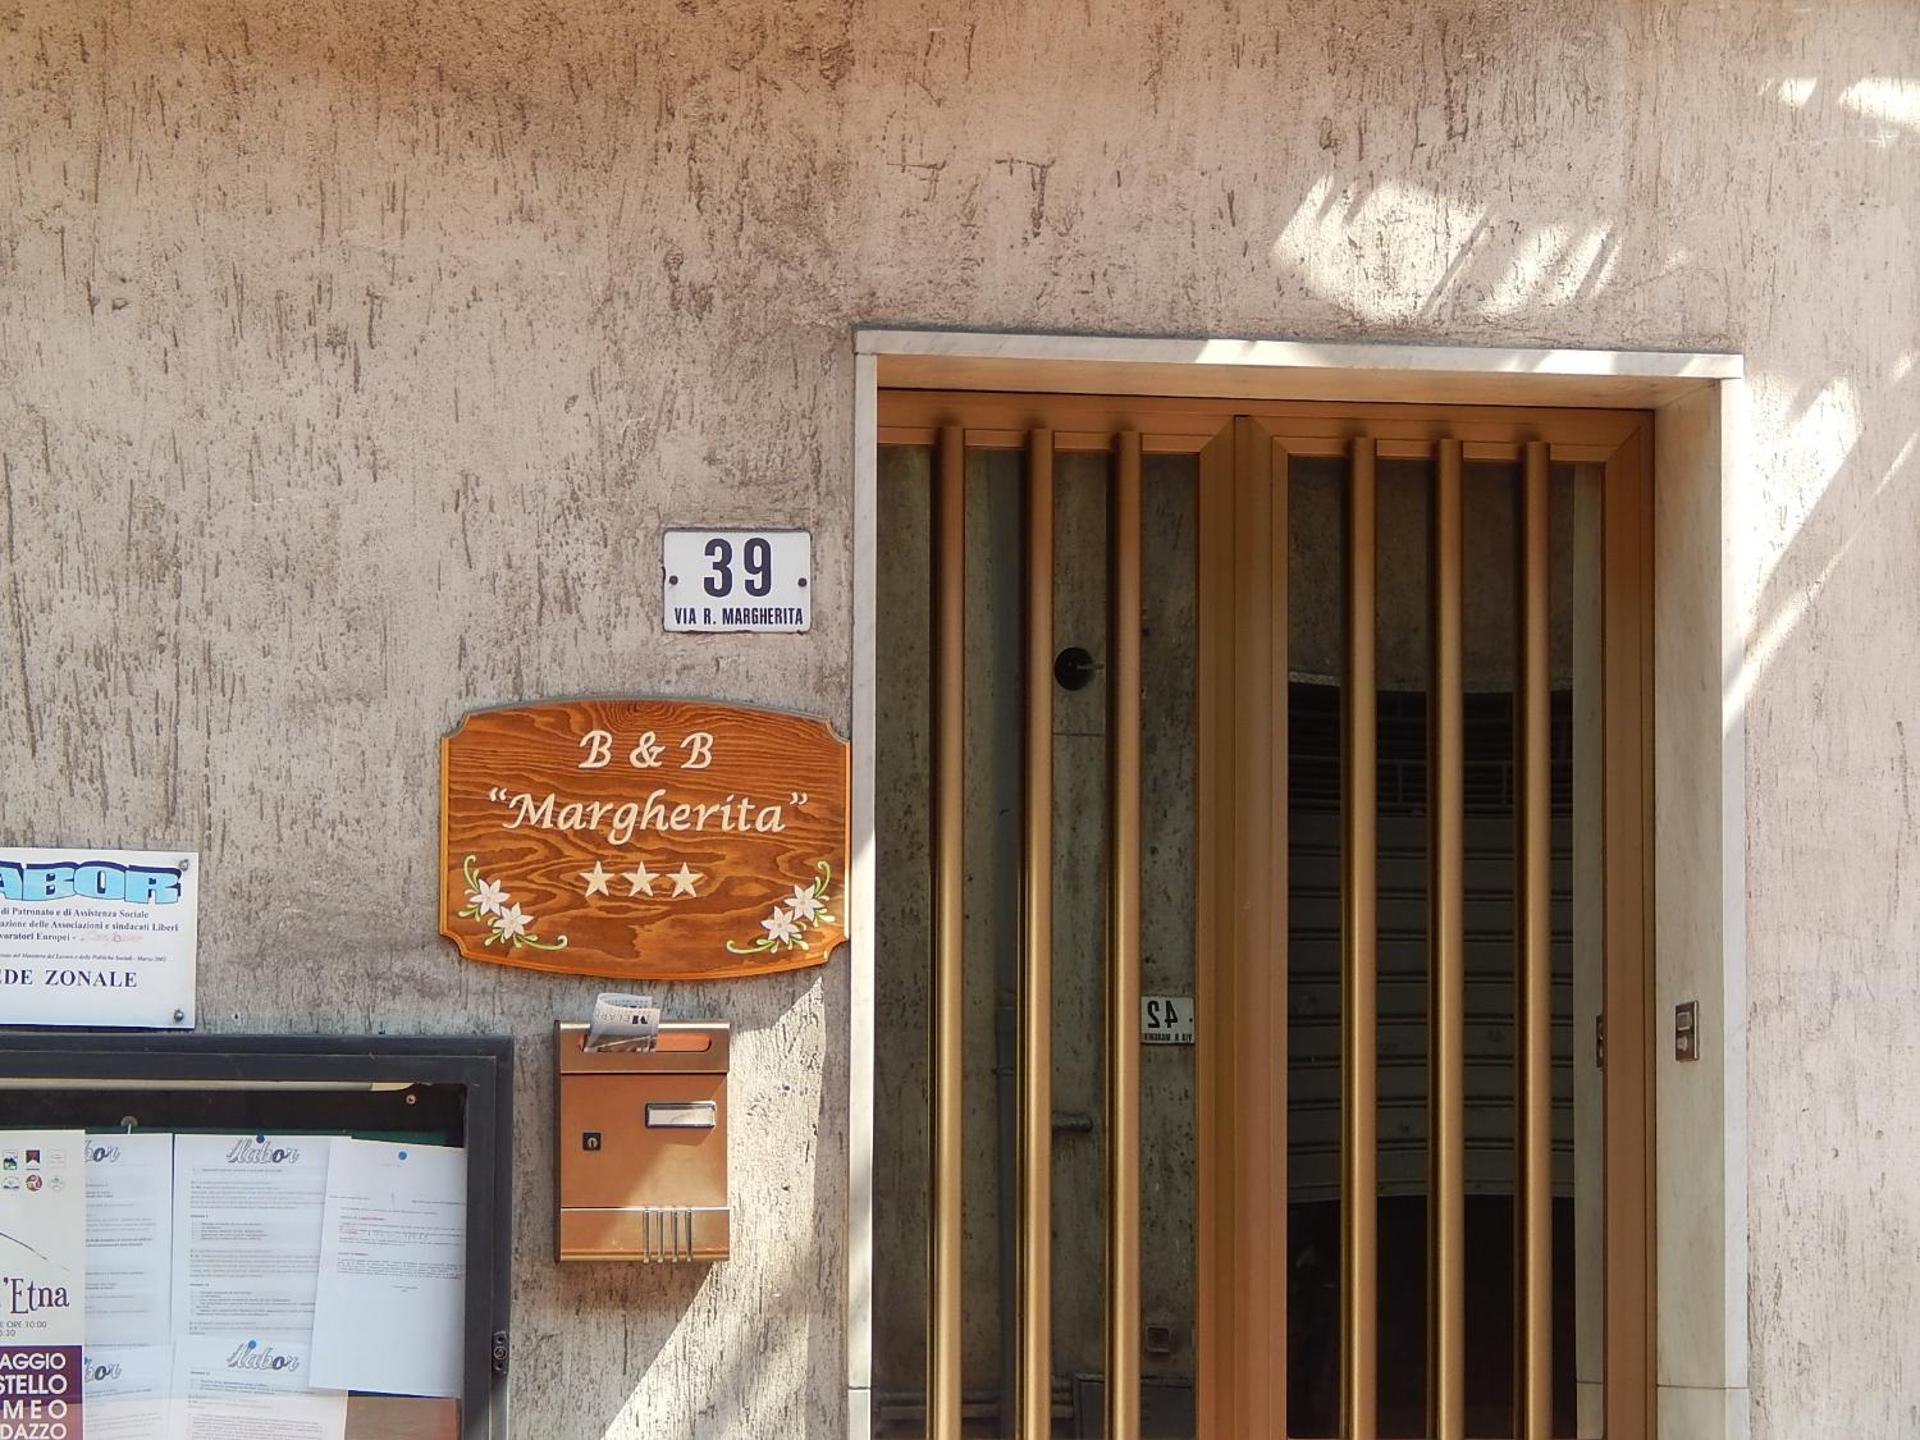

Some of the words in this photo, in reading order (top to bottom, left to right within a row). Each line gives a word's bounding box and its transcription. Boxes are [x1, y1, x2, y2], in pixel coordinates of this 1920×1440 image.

[704, 537, 772, 597] 39
[674, 608, 697, 624] VIA
[703, 608, 717, 624] R.
[722, 608, 803, 624] MARGHERITA
[578, 730, 613, 769] B
[629, 731, 665, 768] &
[681, 732, 714, 769] B
[12, 907, 54, 916] Patronato
[63, 908, 71, 916] di
[73, 909, 117, 917] Assistenza
[119, 910, 149, 918] Sociale
[51, 921, 103, 929] Associazioni
[112, 922, 149, 931] sindacati
[152, 923, 178, 931] Liberi
[36, 932, 70, 942] Europei
[0, 969, 33, 985] DE
[45, 970, 137, 987] ZONALE
[0, 1352, 66, 1370] AGGIO
[0, 1422, 67, 1440] DAZZO
